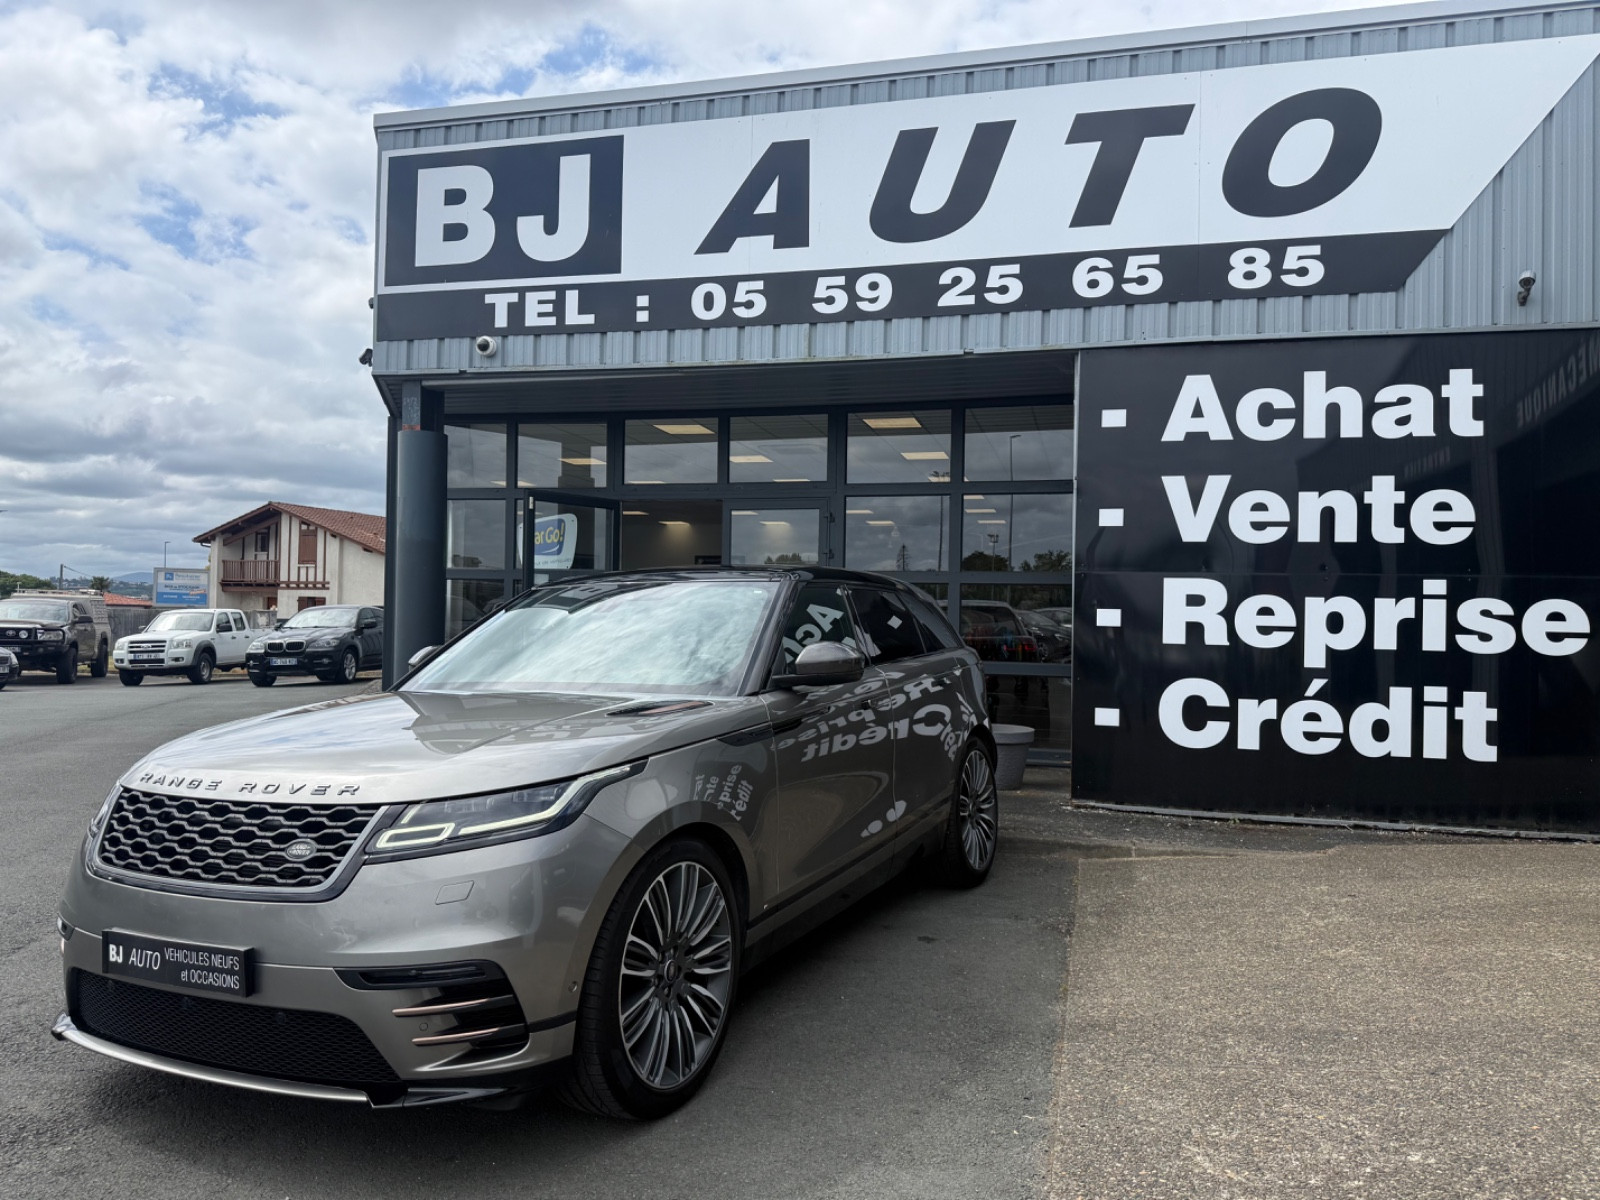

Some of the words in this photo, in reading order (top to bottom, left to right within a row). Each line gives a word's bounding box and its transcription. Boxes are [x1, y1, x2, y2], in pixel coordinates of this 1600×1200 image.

[414, 153, 592, 267] BJ
[693, 87, 1383, 256] AUTO
[485, 289, 595, 328] TEL
[691, 280, 767, 321] 05
[812, 272, 893, 315] 59
[937, 263, 1024, 307] 25
[1072, 253, 1164, 298] 65
[1227, 244, 1325, 290] 85
[1160, 368, 1484, 442] Achat
[546, 523, 565, 544] Go!
[1161, 474, 1476, 545] Vente
[1161, 577, 1590, 669] Reprise
[1158, 677, 1498, 763] Crédit
[139, 772, 222, 791] RANGE
[238, 782, 361, 796] ROVER
[109, 943, 123, 964] BJ
[128, 948, 161, 969] AUTO
[164, 947, 210, 965] VEHICULES
[211, 953, 240, 970] NEUFS
[180, 969, 189, 982] et
[189, 969, 240, 989] OCCASIONS
